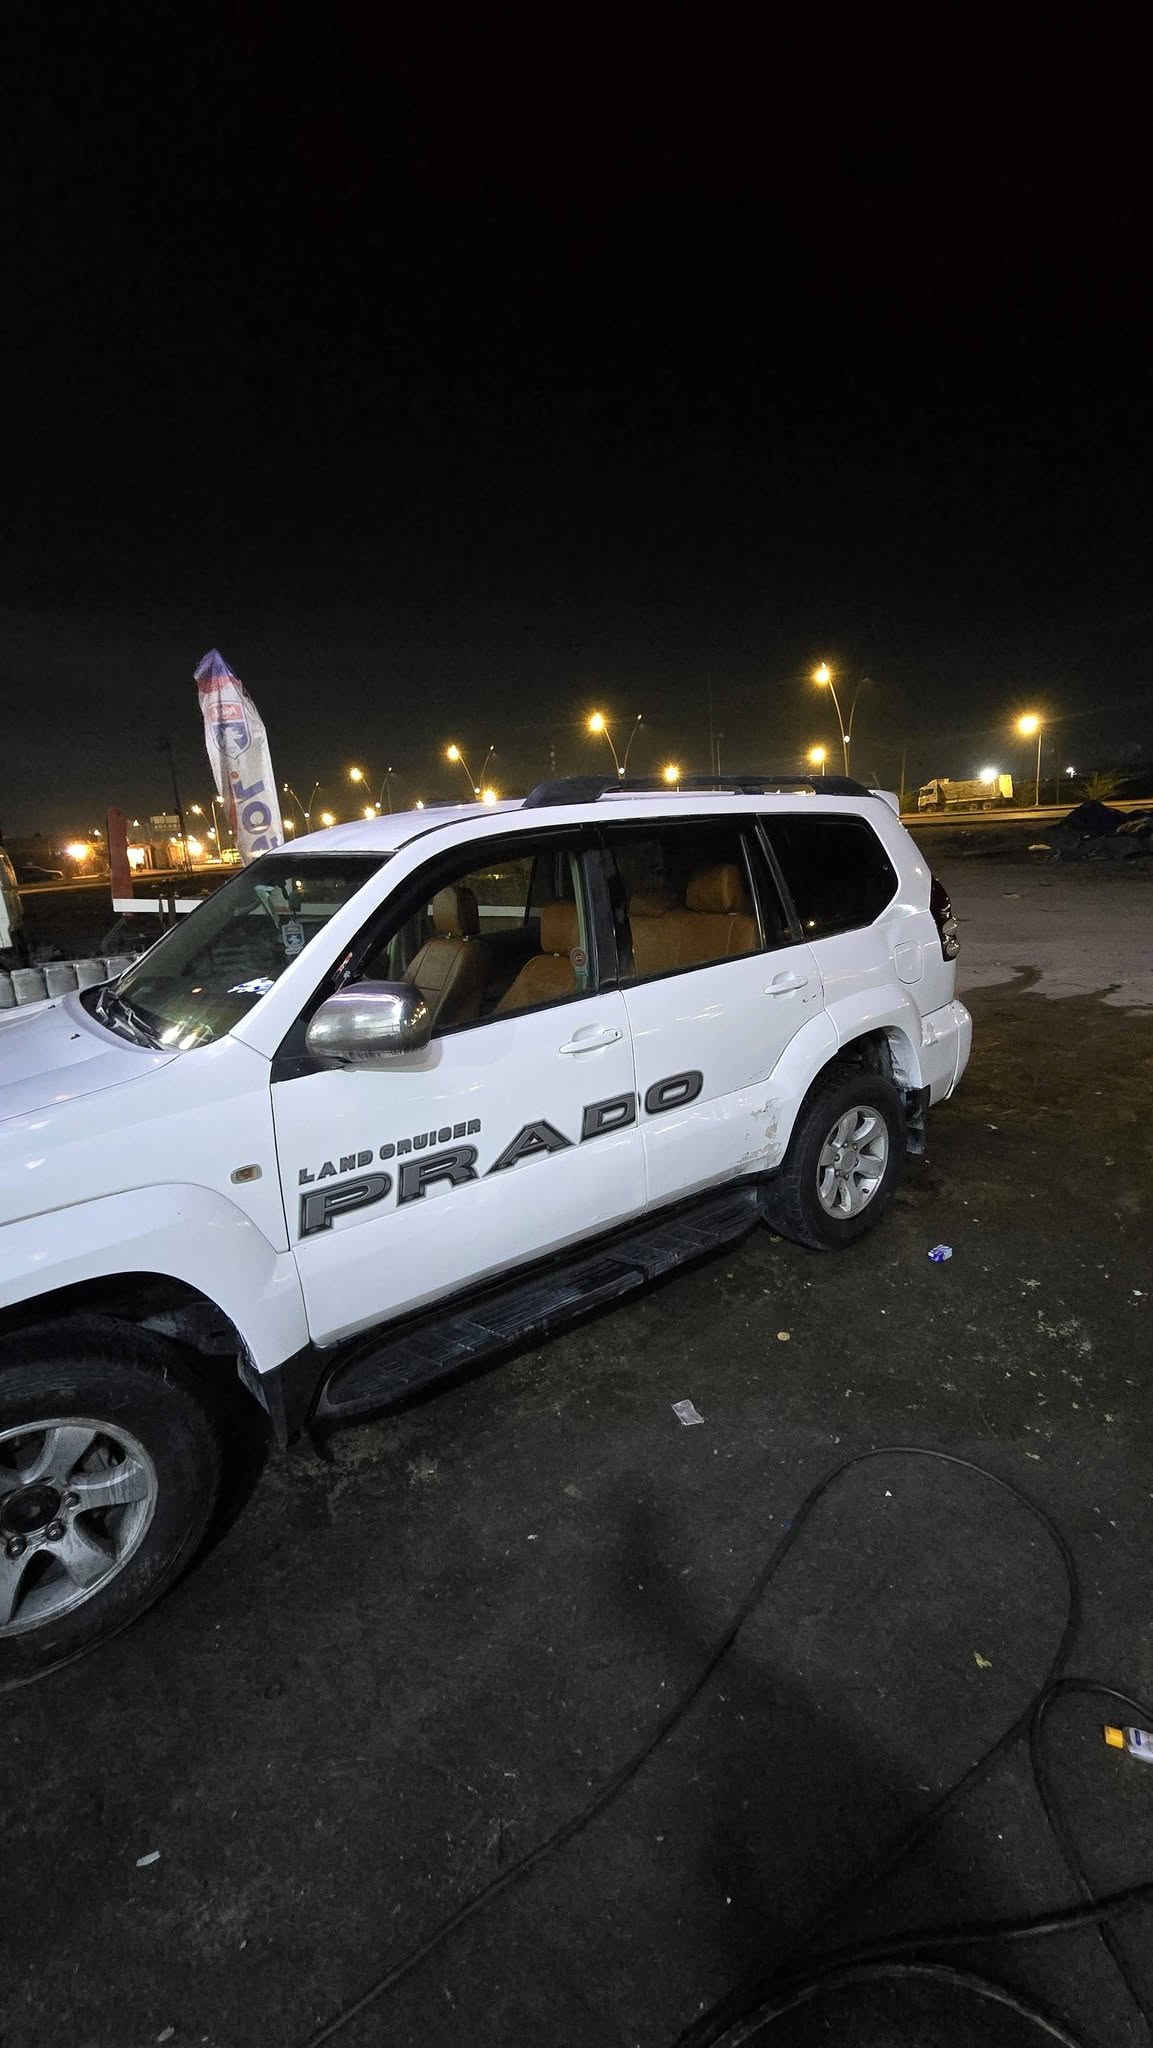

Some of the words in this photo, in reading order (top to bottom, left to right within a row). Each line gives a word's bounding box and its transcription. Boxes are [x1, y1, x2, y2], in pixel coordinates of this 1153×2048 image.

[298, 1149, 374, 1185] LAND
[379, 1118, 482, 1160] CRUISER
[298, 1069, 703, 1240] PRADO
